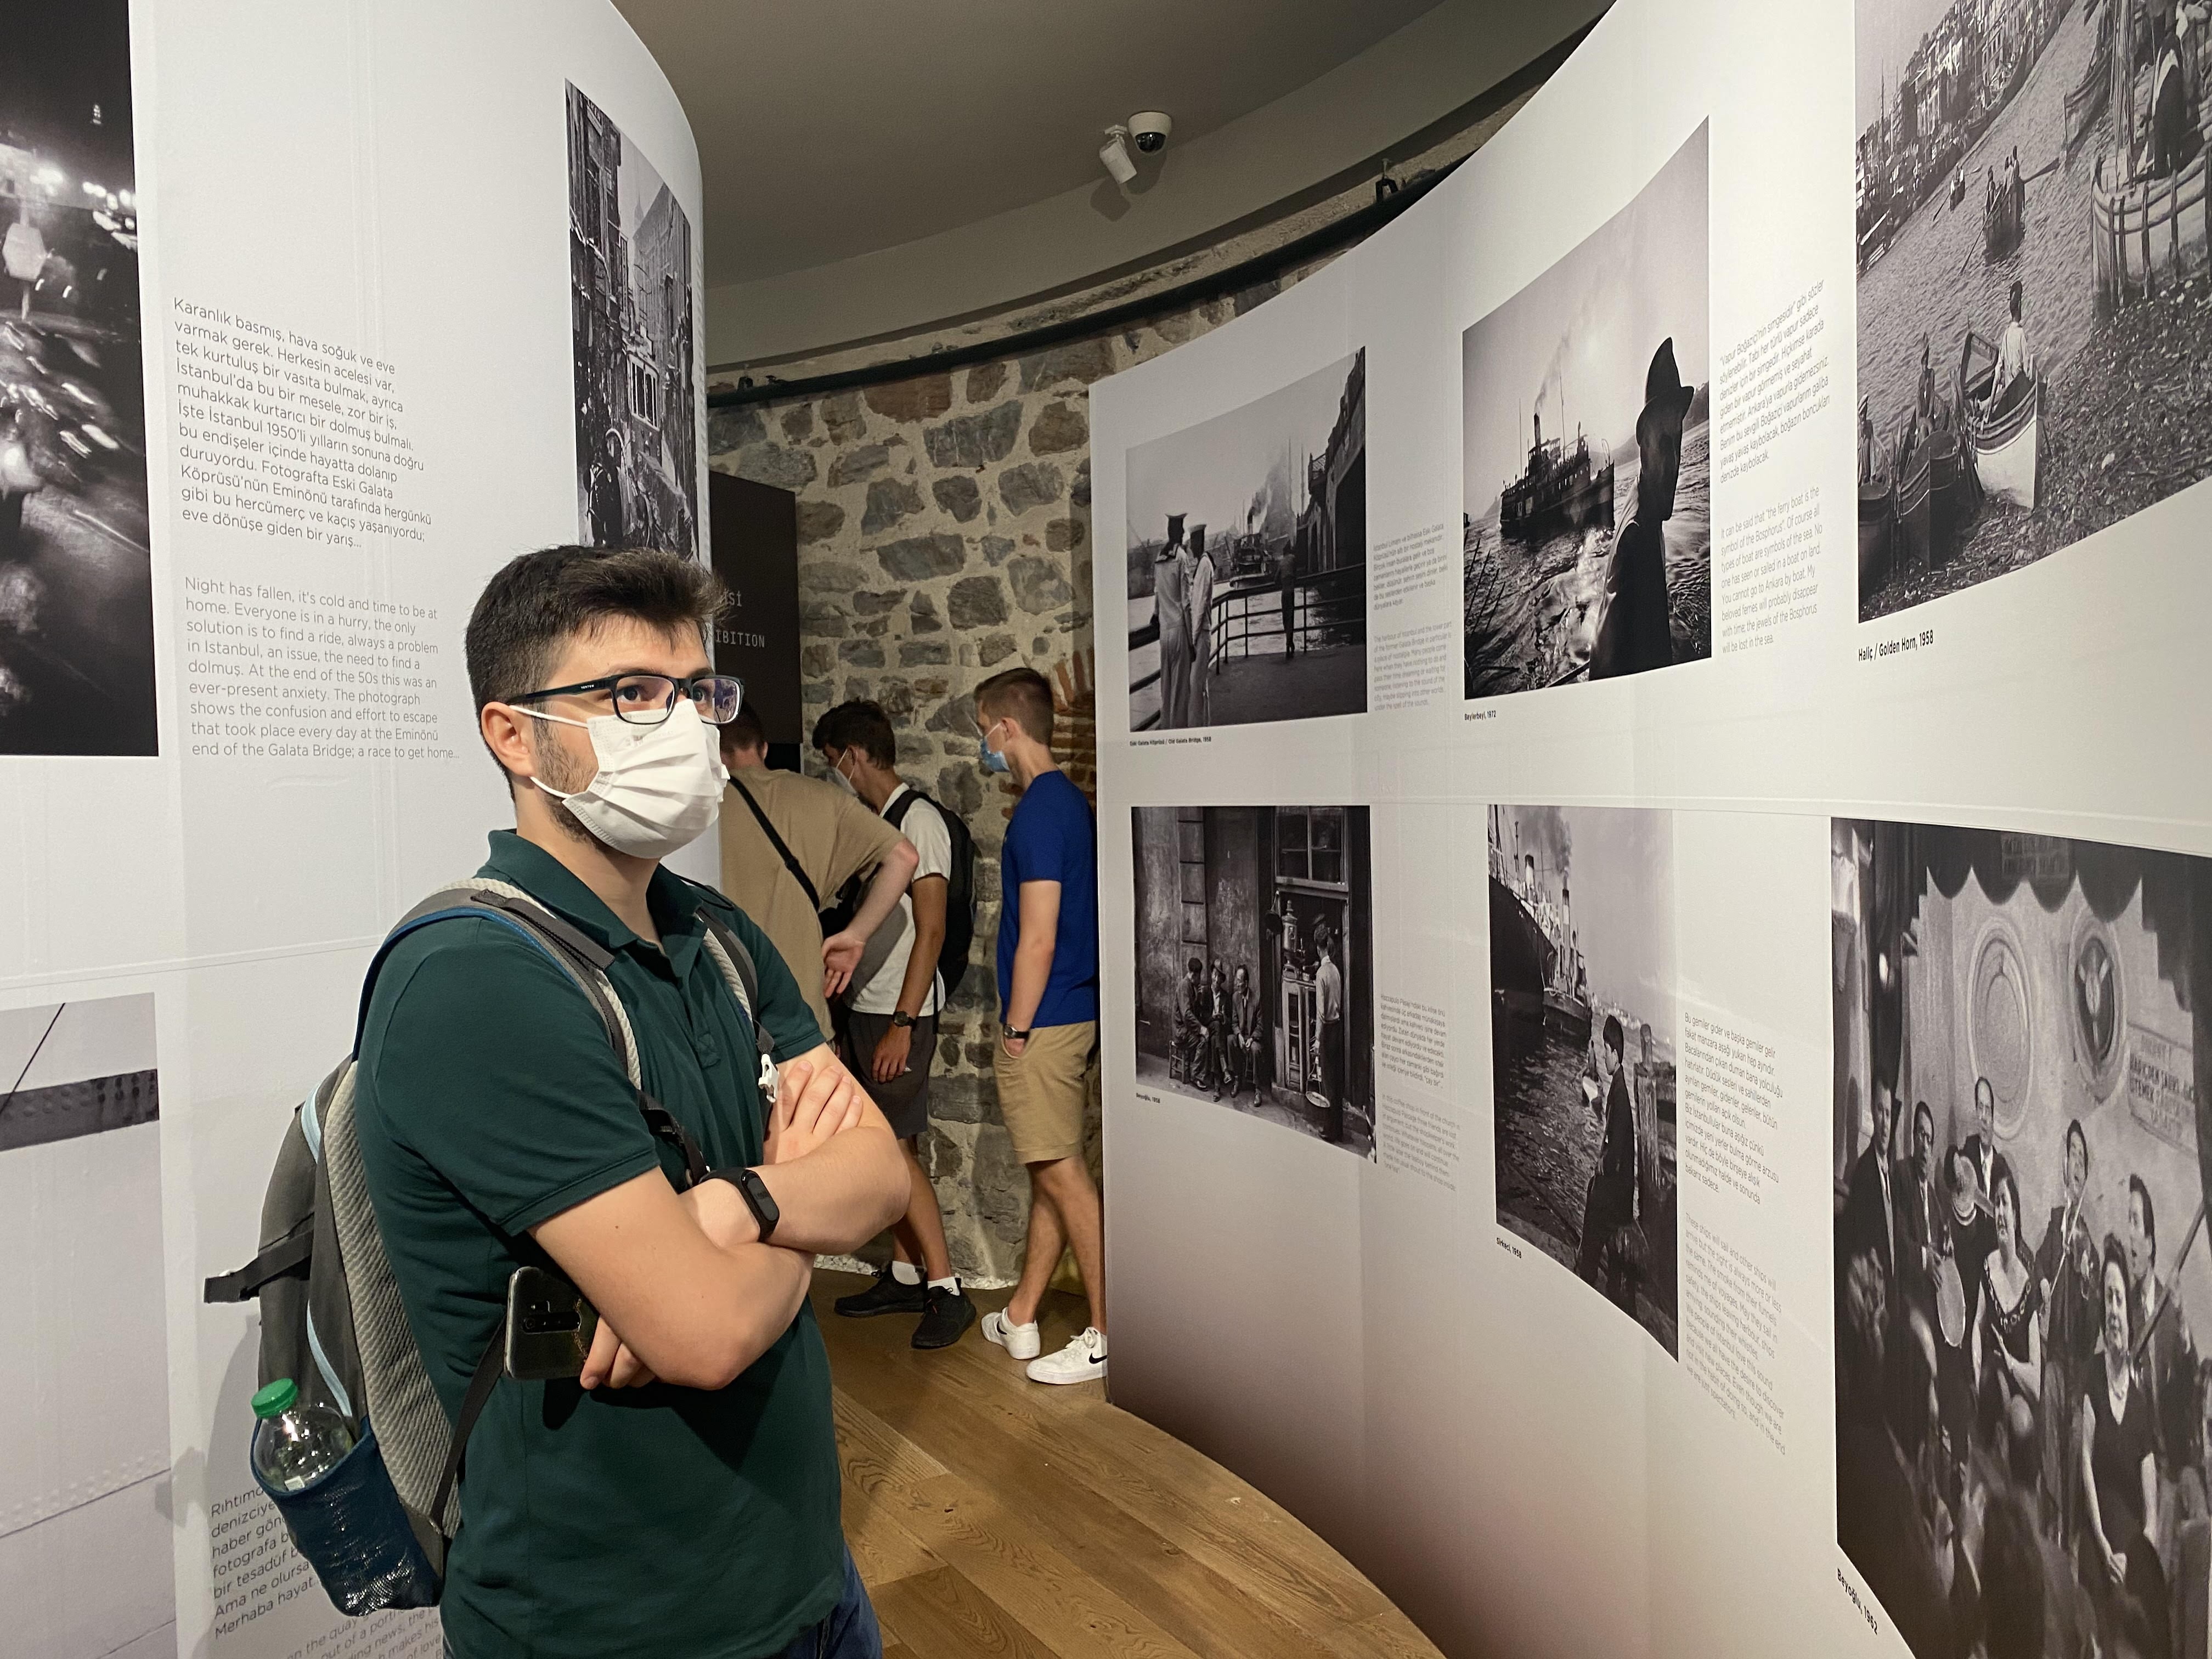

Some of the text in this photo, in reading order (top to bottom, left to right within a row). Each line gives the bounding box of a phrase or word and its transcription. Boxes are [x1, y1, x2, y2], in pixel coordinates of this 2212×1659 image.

[174, 297, 394, 374] Karanlık basmış, hava soğuk ve eve
[174, 321, 394, 394] varmak gerek. Herkesin acelesi var,
[176, 339, 403, 413] tek kurtuluş bir vasıta bulmak, ayrıca
[177, 356, 396, 430] İstanbul'da bu bir mesele, zor bir iş,
[178, 384, 413, 451] muhakkak kurtarıcı bir dolmuş bulmalı.
[179, 398, 424, 471] İşte İstanbul 1950'li yılların sonuna doğru
[179, 422, 397, 484] bu endişeler içinde hayatta dolanıp
[180, 443, 393, 501] duruyordu. Fotografta Eski Galata
[182, 464, 431, 525] Köprüsü'nün Eminönü tarafında hergünkü
[182, 486, 424, 542] gibi bu hercümerç ve kaçış yaşanıyordu;
[183, 509, 208, 522] eve
[213, 512, 263, 532] dönüşe
[267, 521, 302, 538] giden
[307, 527, 323, 540] bir
[185, 577, 437, 619] Night has fallen, it's cold and time to be at
[186, 597, 415, 636] home. Everyone is in a hurry, the only
[187, 619, 438, 654] solution is to find a ride, always a problem
[188, 639, 420, 669] in Istanbul, an issue, the need to find a
[715, 630, 765, 648] IBITION
[1858, 646, 1872, 662] Haliç
[1880, 640, 1899, 656] Golden
[1901, 637, 1917, 651] Horn,
[1920, 629, 1933, 646] 1958
[189, 658, 437, 688] dolmuş. At the end of the 50s this was an
[1837, 1568, 1877, 1635] Beyoğlu, 1962
